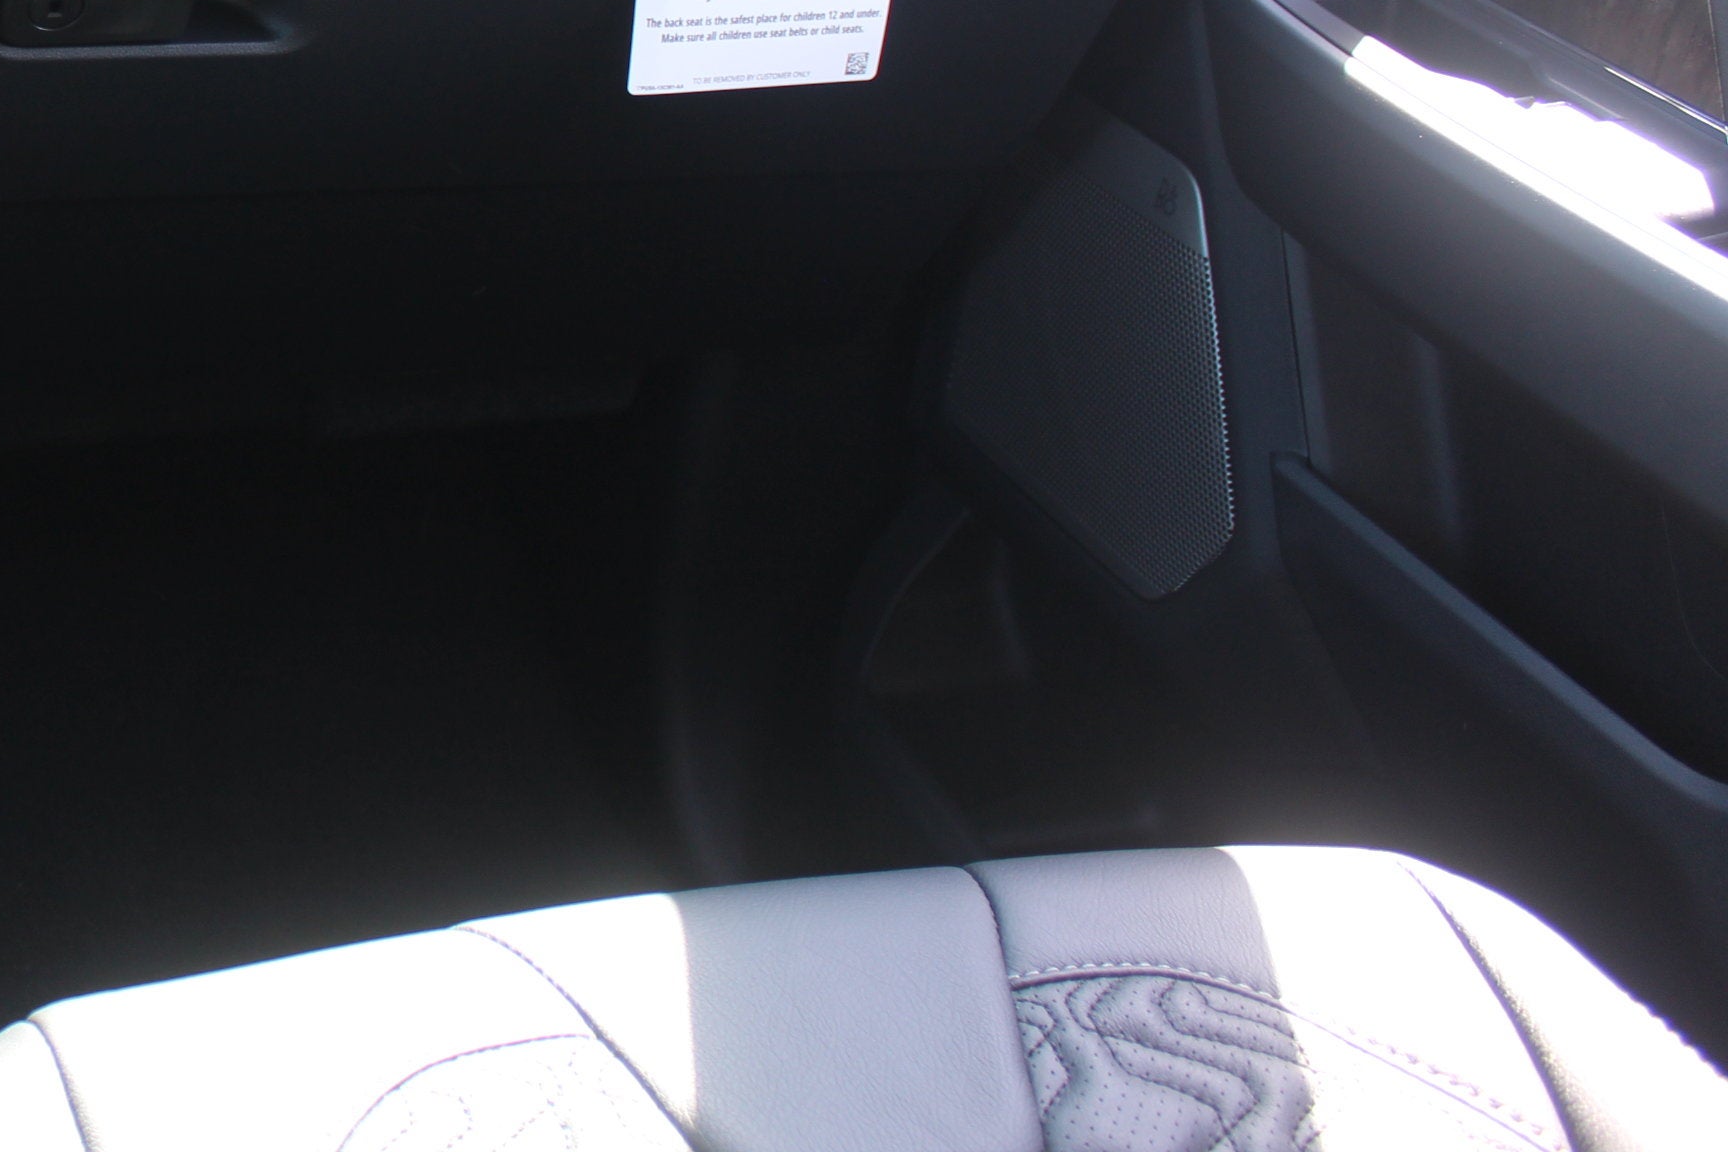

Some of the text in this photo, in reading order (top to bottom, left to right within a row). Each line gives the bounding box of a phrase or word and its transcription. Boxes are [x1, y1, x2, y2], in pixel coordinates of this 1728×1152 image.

[646, 17, 662, 28] The
[664, 17, 683, 28] back
[686, 17, 703, 27] seat
[705, 16, 713, 26] is
[714, 16, 728, 26] the
[729, 14, 754, 25] safest
[756, 13, 778, 26] place
[779, 12, 791, 23] for
[793, 11, 826, 22] children
[828, 10, 837, 20] 12
[839, 10, 855, 19] and
[661, 33, 684, 43] Make
[686, 33, 704, 42] sure
[706, 31, 717, 41] all
[719, 30, 752, 40] children
[753, 30, 768, 39] use
[769, 28, 787, 38] seat
[789, 27, 808, 37] belts
[810, 27, 819, 36] or
[821, 25, 840, 35] child
